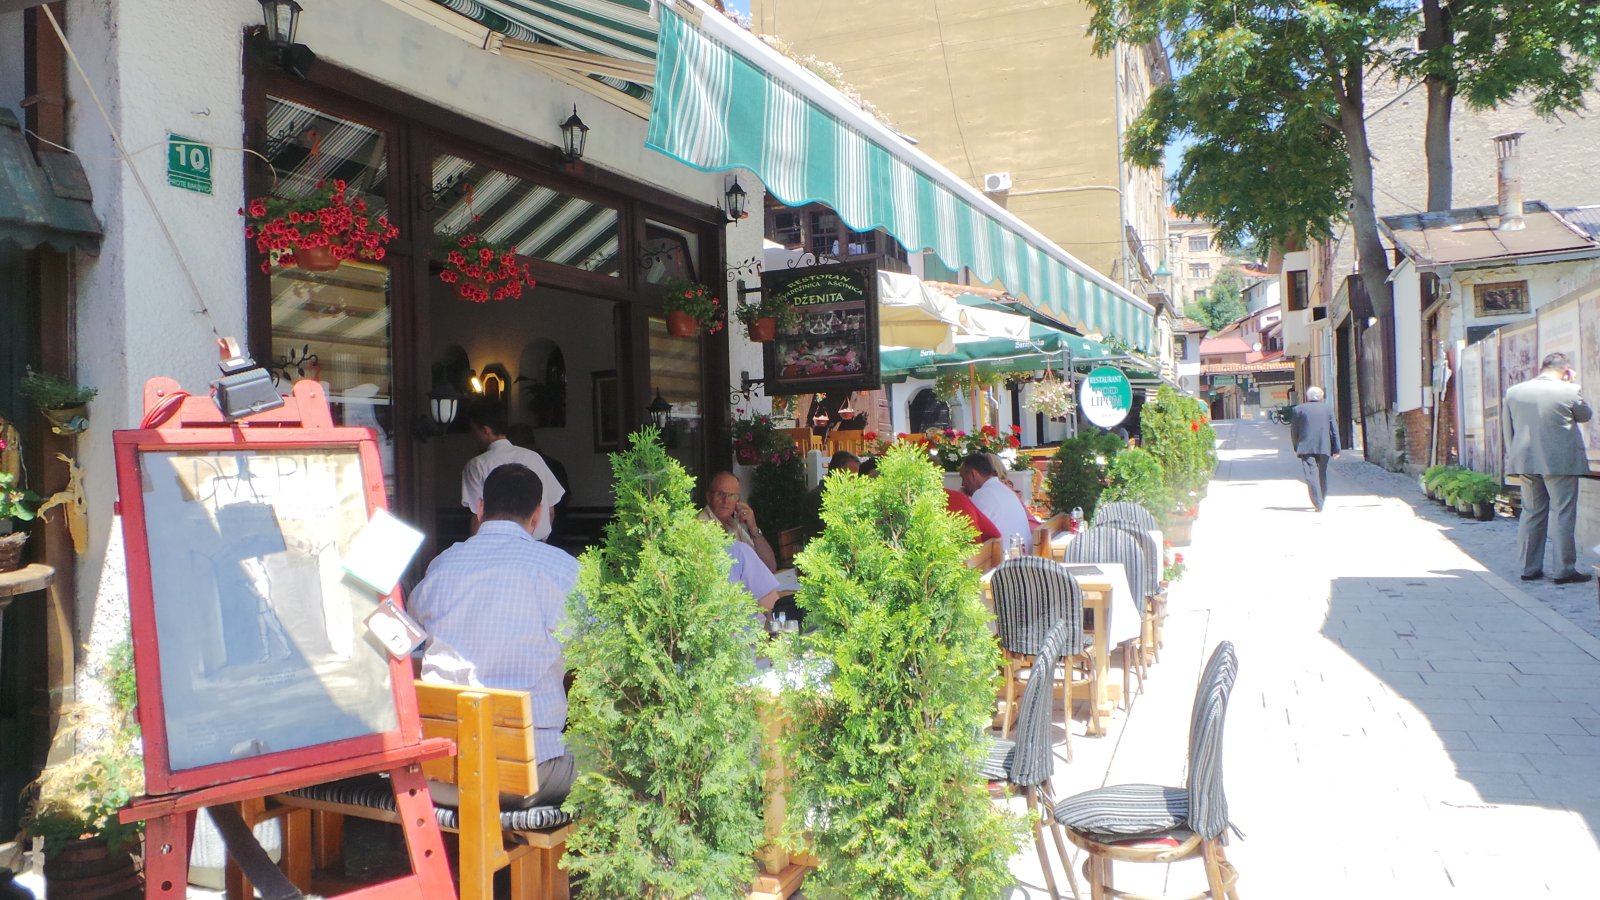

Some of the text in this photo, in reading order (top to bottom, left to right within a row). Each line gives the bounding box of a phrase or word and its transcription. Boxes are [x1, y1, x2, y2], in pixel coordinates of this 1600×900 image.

[176, 145, 205, 170] 10
[787, 274, 851, 288] RESTORAN
[794, 293, 844, 305] DŽENITA
[1089, 375, 1123, 384] RESTAURANT
